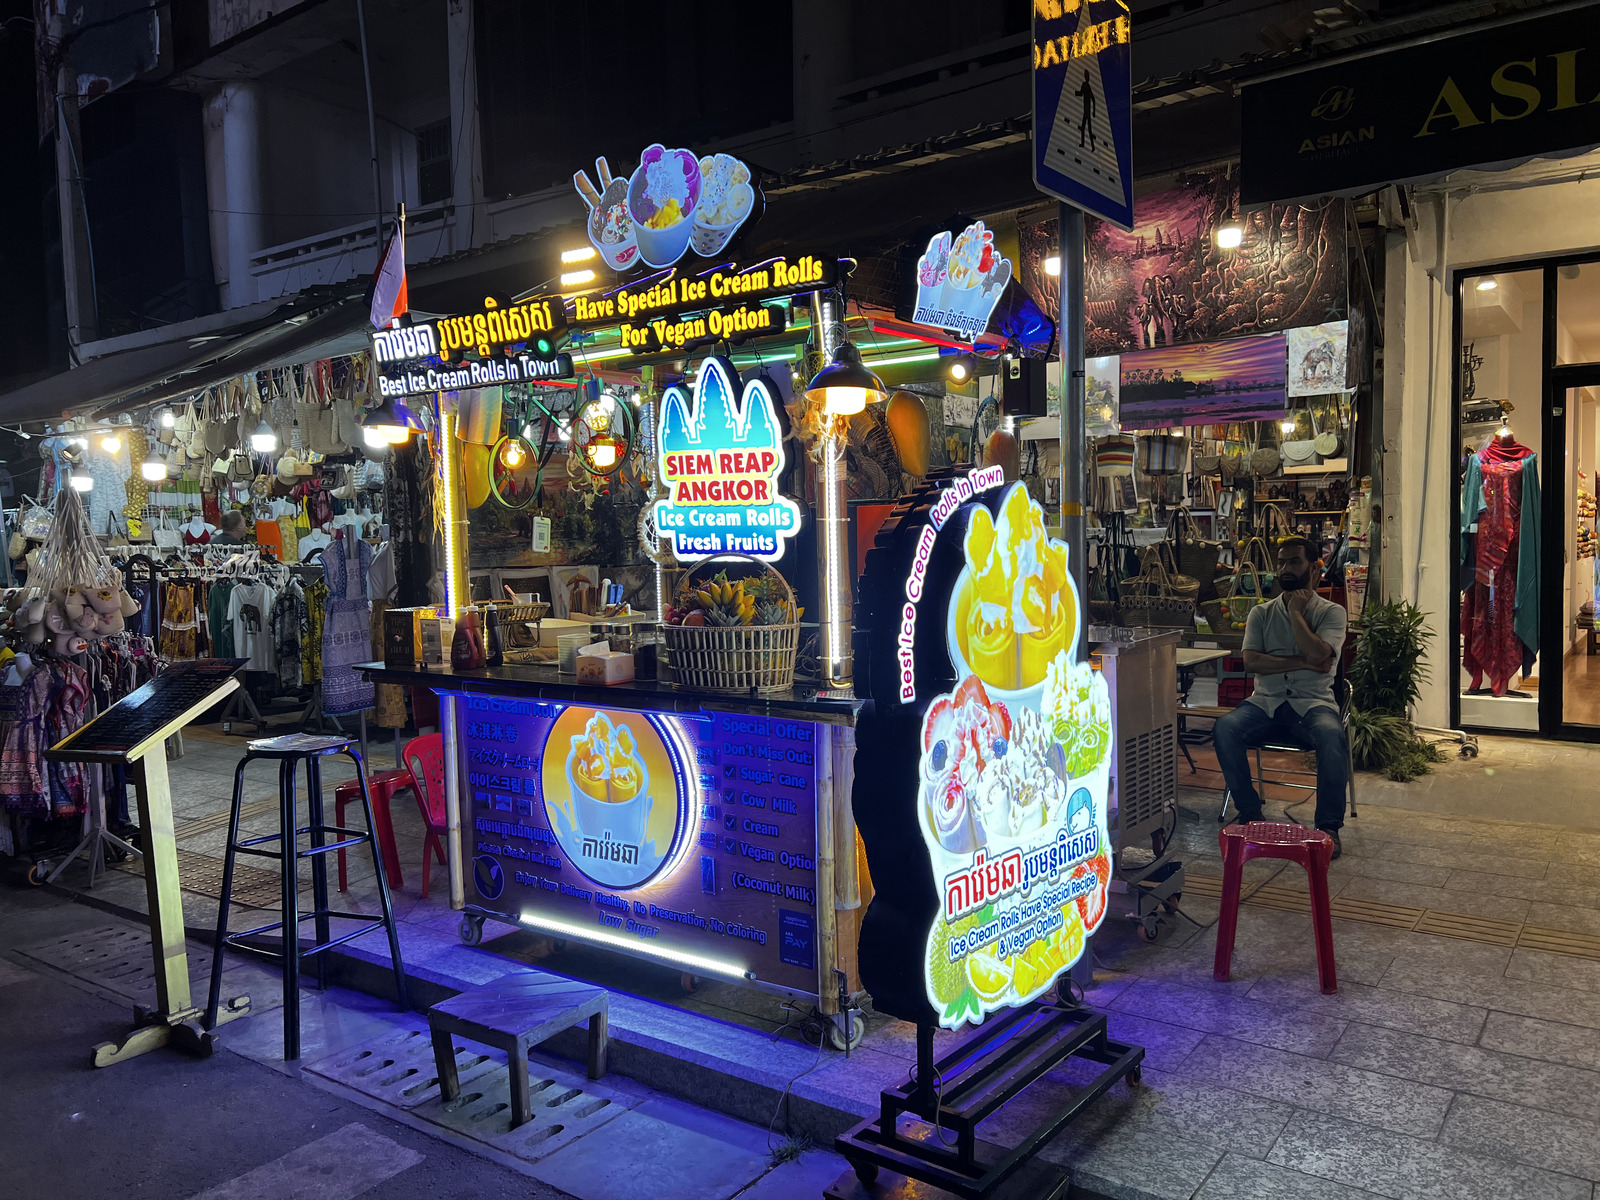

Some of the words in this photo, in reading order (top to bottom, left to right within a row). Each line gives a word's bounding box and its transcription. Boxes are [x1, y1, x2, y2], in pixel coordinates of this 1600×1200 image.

[1413, 47, 1600, 138] ASI
[1298, 126, 1375, 153] ASIAN
[575, 297, 614, 320] Have
[617, 281, 676, 317] Special
[681, 278, 706, 302] Ice
[710, 271, 769, 297] Cream
[773, 255, 823, 288] Rolls
[620, 323, 649, 347] For
[653, 317, 706, 346] Vegan
[708, 306, 771, 339] Option
[379, 374, 408, 396] Best
[409, 371, 427, 392] Ice
[427, 363, 471, 390] Cream
[471, 359, 505, 384] Rolls
[506, 358, 519, 380] In
[519, 355, 560, 378] Town
[666, 454, 713, 476] SIEM
[720, 451, 774, 474] REAP
[956, 481, 971, 499] In
[970, 467, 1003, 489] Town
[677, 479, 768, 502] ANGKOR
[660, 510, 685, 527] Ice
[689, 508, 741, 527] Cream
[746, 507, 790, 526] Rolls
[932, 491, 957, 527] Rolls
[679, 533, 721, 551] Fresh
[726, 532, 774, 551] Fruits
[909, 528, 935, 599] Cream
[902, 605, 914, 644] Ice
[902, 652, 914, 698] Best
[467, 722, 502, 740] 冰淇淋
[722, 717, 770, 737] Special
[775, 723, 813, 741] Offer
[469, 748, 541, 771] アイスクリームロー
[723, 742, 754, 757] Don't
[758, 746, 784, 762] Miss
[787, 749, 813, 764] Out:
[469, 773, 521, 794] 아이스크림
[740, 767, 774, 784] Sugar
[778, 773, 807, 789] cane
[741, 792, 766, 808] Cow
[772, 797, 798, 815] Milk
[743, 818, 780, 837] Cream
[545, 856, 562, 868] First
[740, 842, 775, 861] Vegan
[732, 872, 782, 895] (Coconut
[785, 886, 816, 906] Milk)
[515, 871, 537, 887] Enjoy
[560, 883, 592, 902] Delivery
[595, 891, 631, 911] Healthy,
[634, 901, 647, 915] No
[650, 903, 708, 930] Preservation,
[710, 918, 725, 933] No
[726, 922, 767, 945] Coloring
[950, 937, 966, 957] Ice
[969, 923, 999, 945] Cream
[1001, 911, 1019, 931] Rolls
[1021, 903, 1042, 922] Have
[1043, 888, 1070, 910] Special
[1071, 874, 1096, 897] Recipe
[599, 911, 622, 929] Low
[625, 919, 659, 939] Sugar
[999, 938, 1006, 954] &
[1007, 929, 1034, 949] Vegan
[1036, 912, 1062, 936] Option
